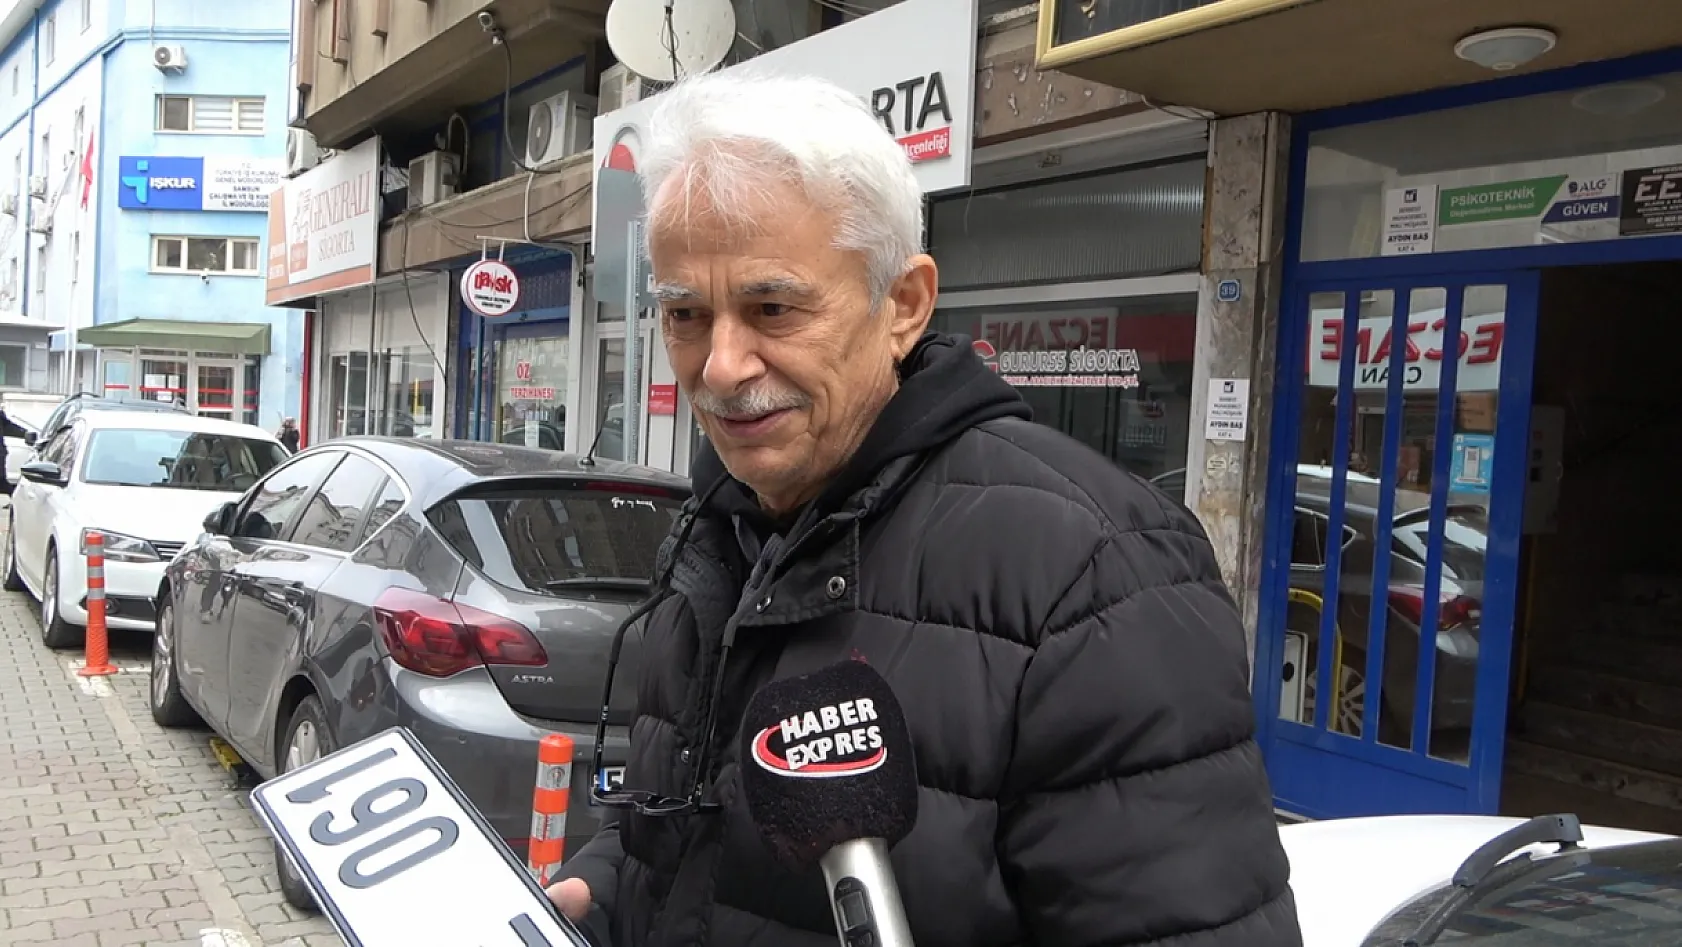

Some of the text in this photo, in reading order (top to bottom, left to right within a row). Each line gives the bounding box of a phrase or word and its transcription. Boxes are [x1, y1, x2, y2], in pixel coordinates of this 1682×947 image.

[872, 71, 953, 137] RTA
[1450, 185, 1536, 208] PSİKOTEKNİK
[1579, 178, 1607, 192] ALG
[1562, 202, 1609, 217] GÜVEN
[1000, 344, 1141, 373] GURUR55 SİGORTA
[511, 674, 554, 684] ASTRA
[780, 697, 878, 744] HABER
[785, 726, 884, 771] EXPRES
